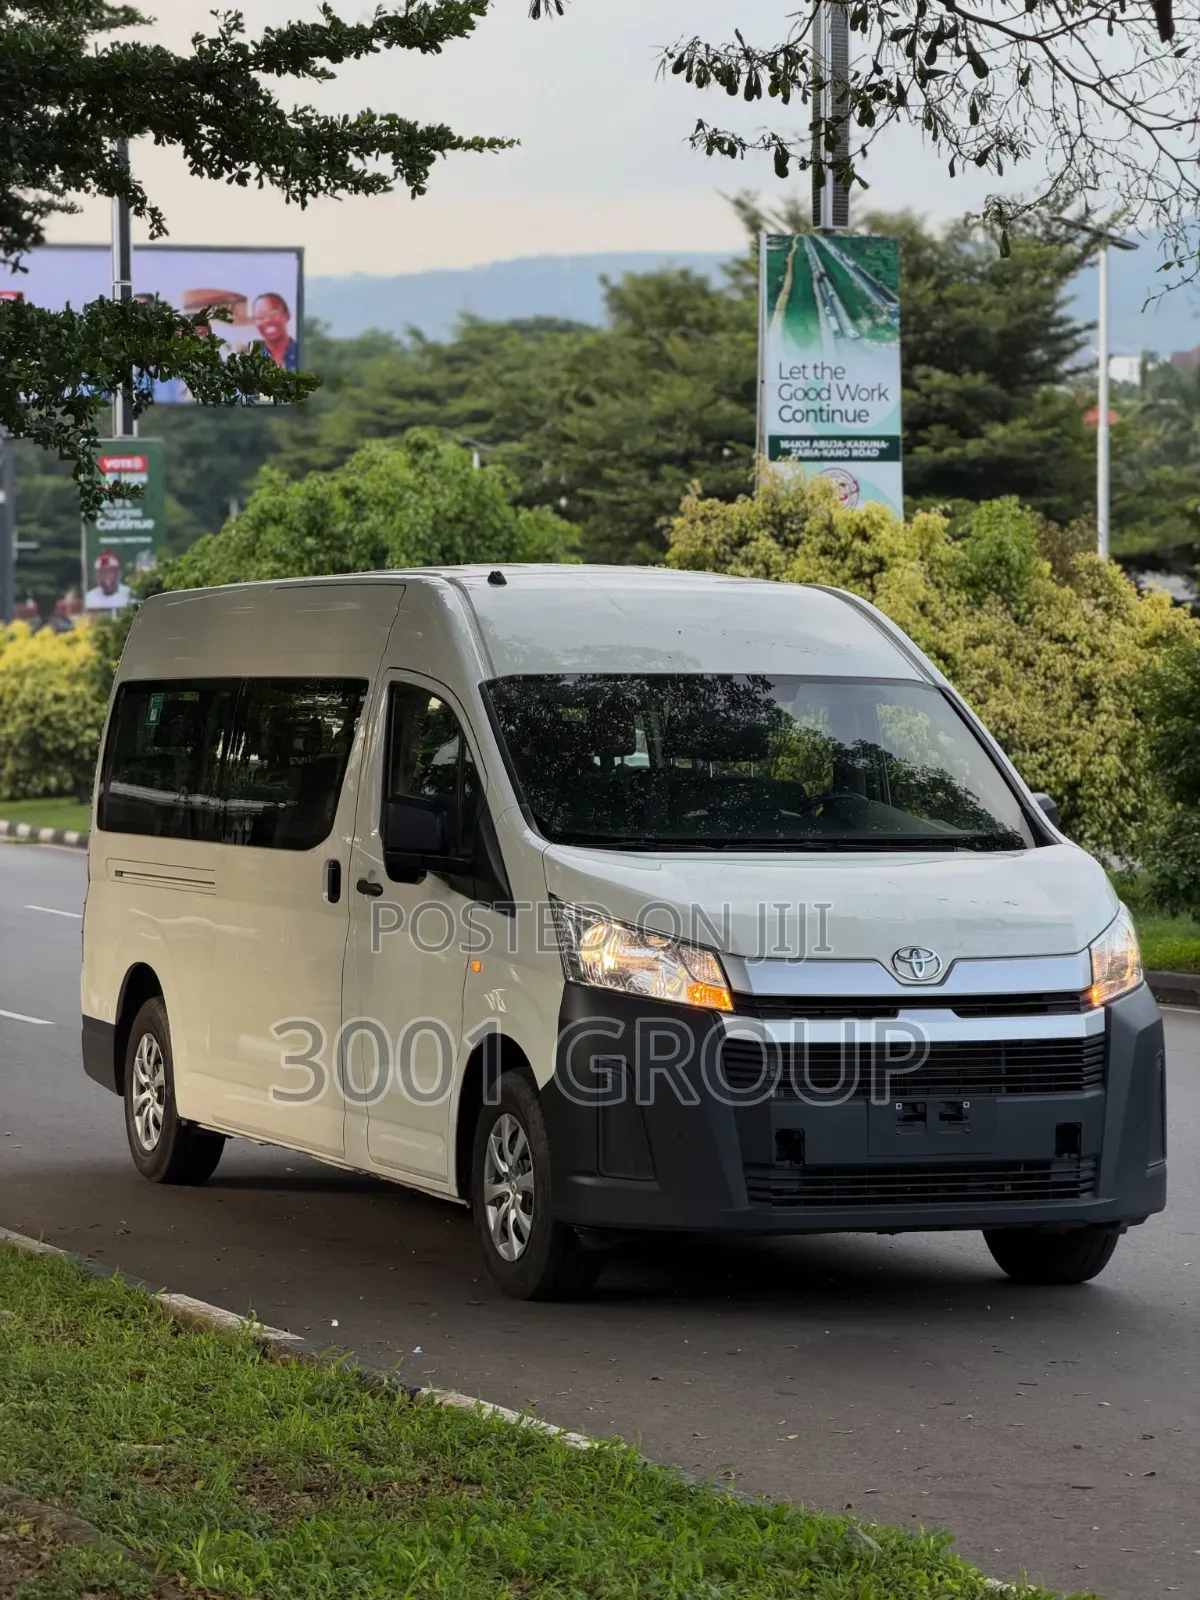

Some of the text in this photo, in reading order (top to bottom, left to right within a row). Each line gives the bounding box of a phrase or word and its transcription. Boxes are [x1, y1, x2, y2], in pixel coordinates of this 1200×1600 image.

[778, 361, 846, 380] Let the
[778, 382, 890, 402] Good Work
[778, 403, 870, 423] Continue
[851, 448, 880, 457] ROAD
